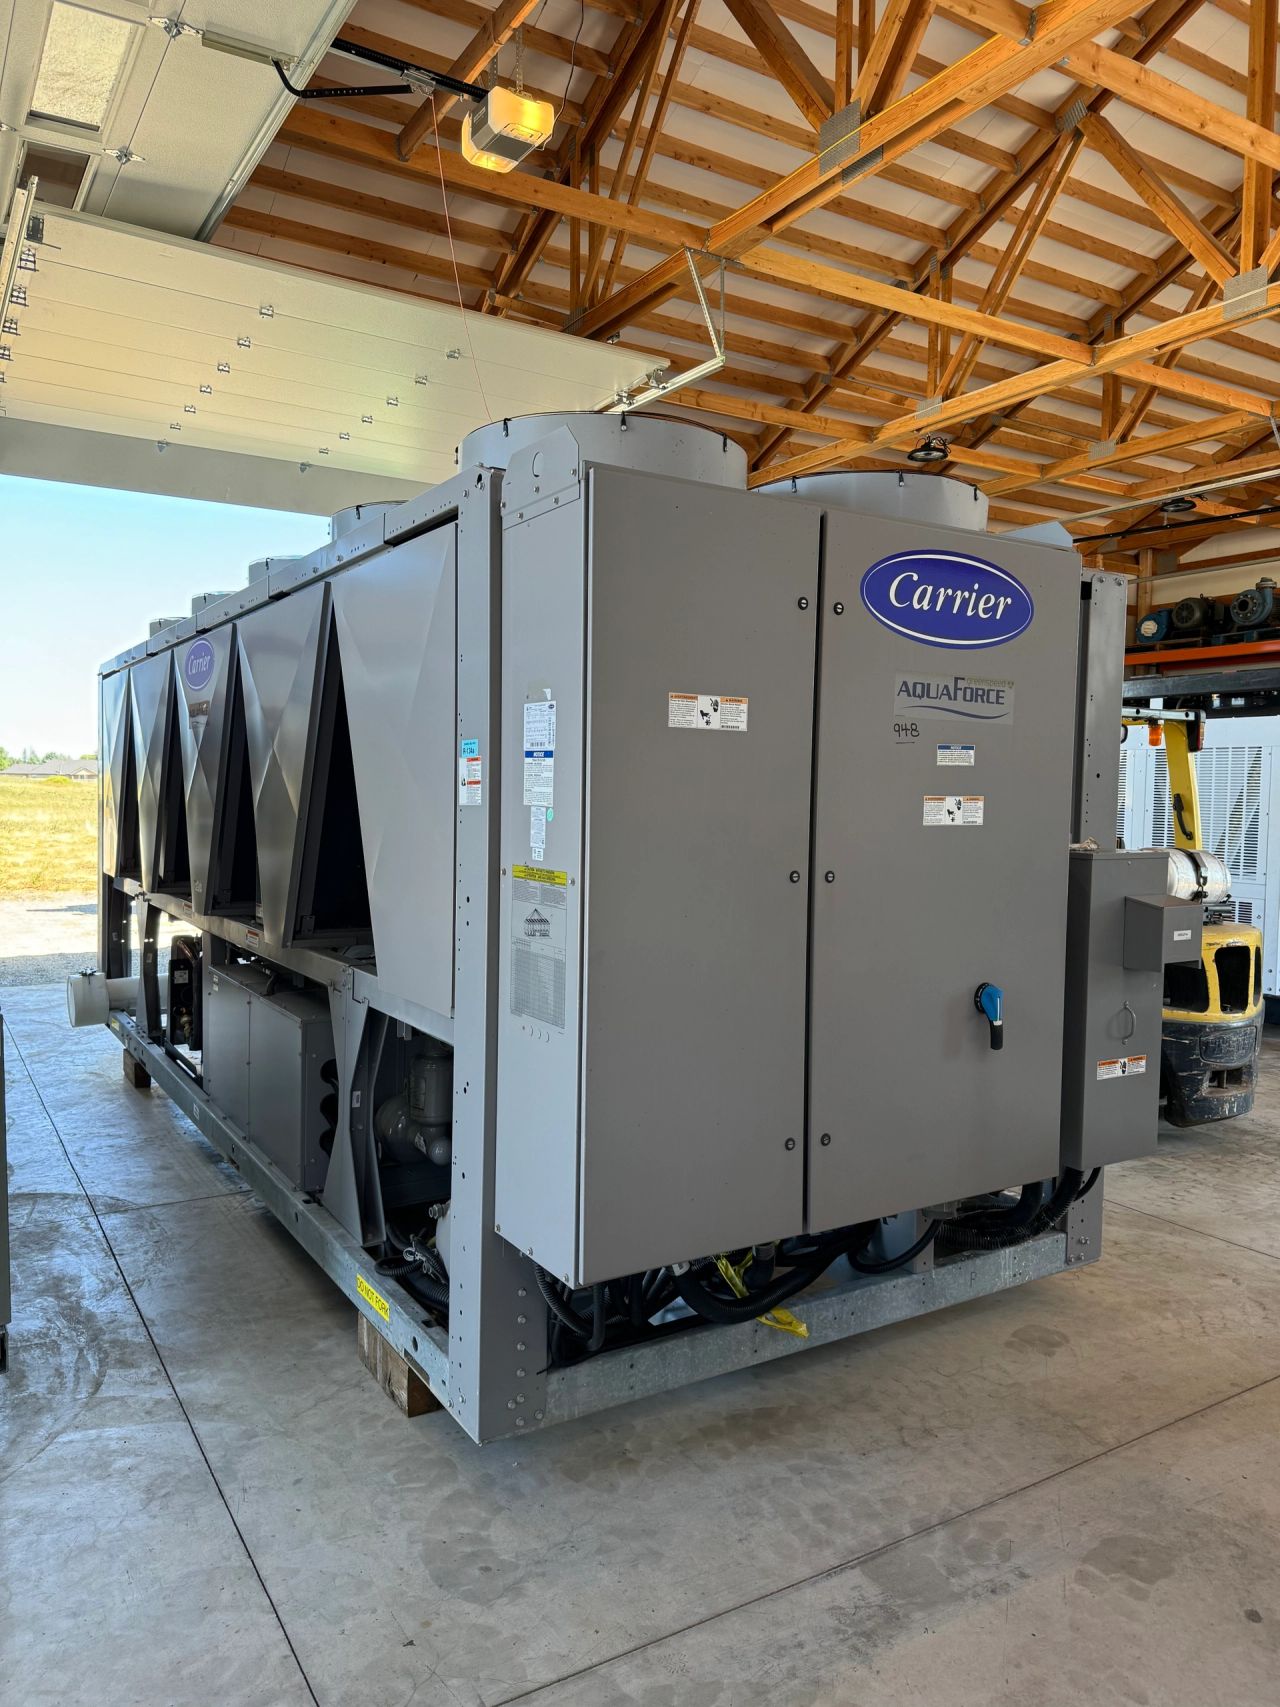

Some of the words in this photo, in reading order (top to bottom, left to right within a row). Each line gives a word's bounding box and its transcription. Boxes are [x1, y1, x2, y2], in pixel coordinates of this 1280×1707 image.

[889, 572, 1012, 620] Carrier
[188, 652, 210, 675] Carrier
[897, 677, 1005, 705] AQUAFORCE
[893, 723, 920, 738] 948
[357, 1277, 364, 1293] DO
[364, 1285, 375, 1304] NOT
